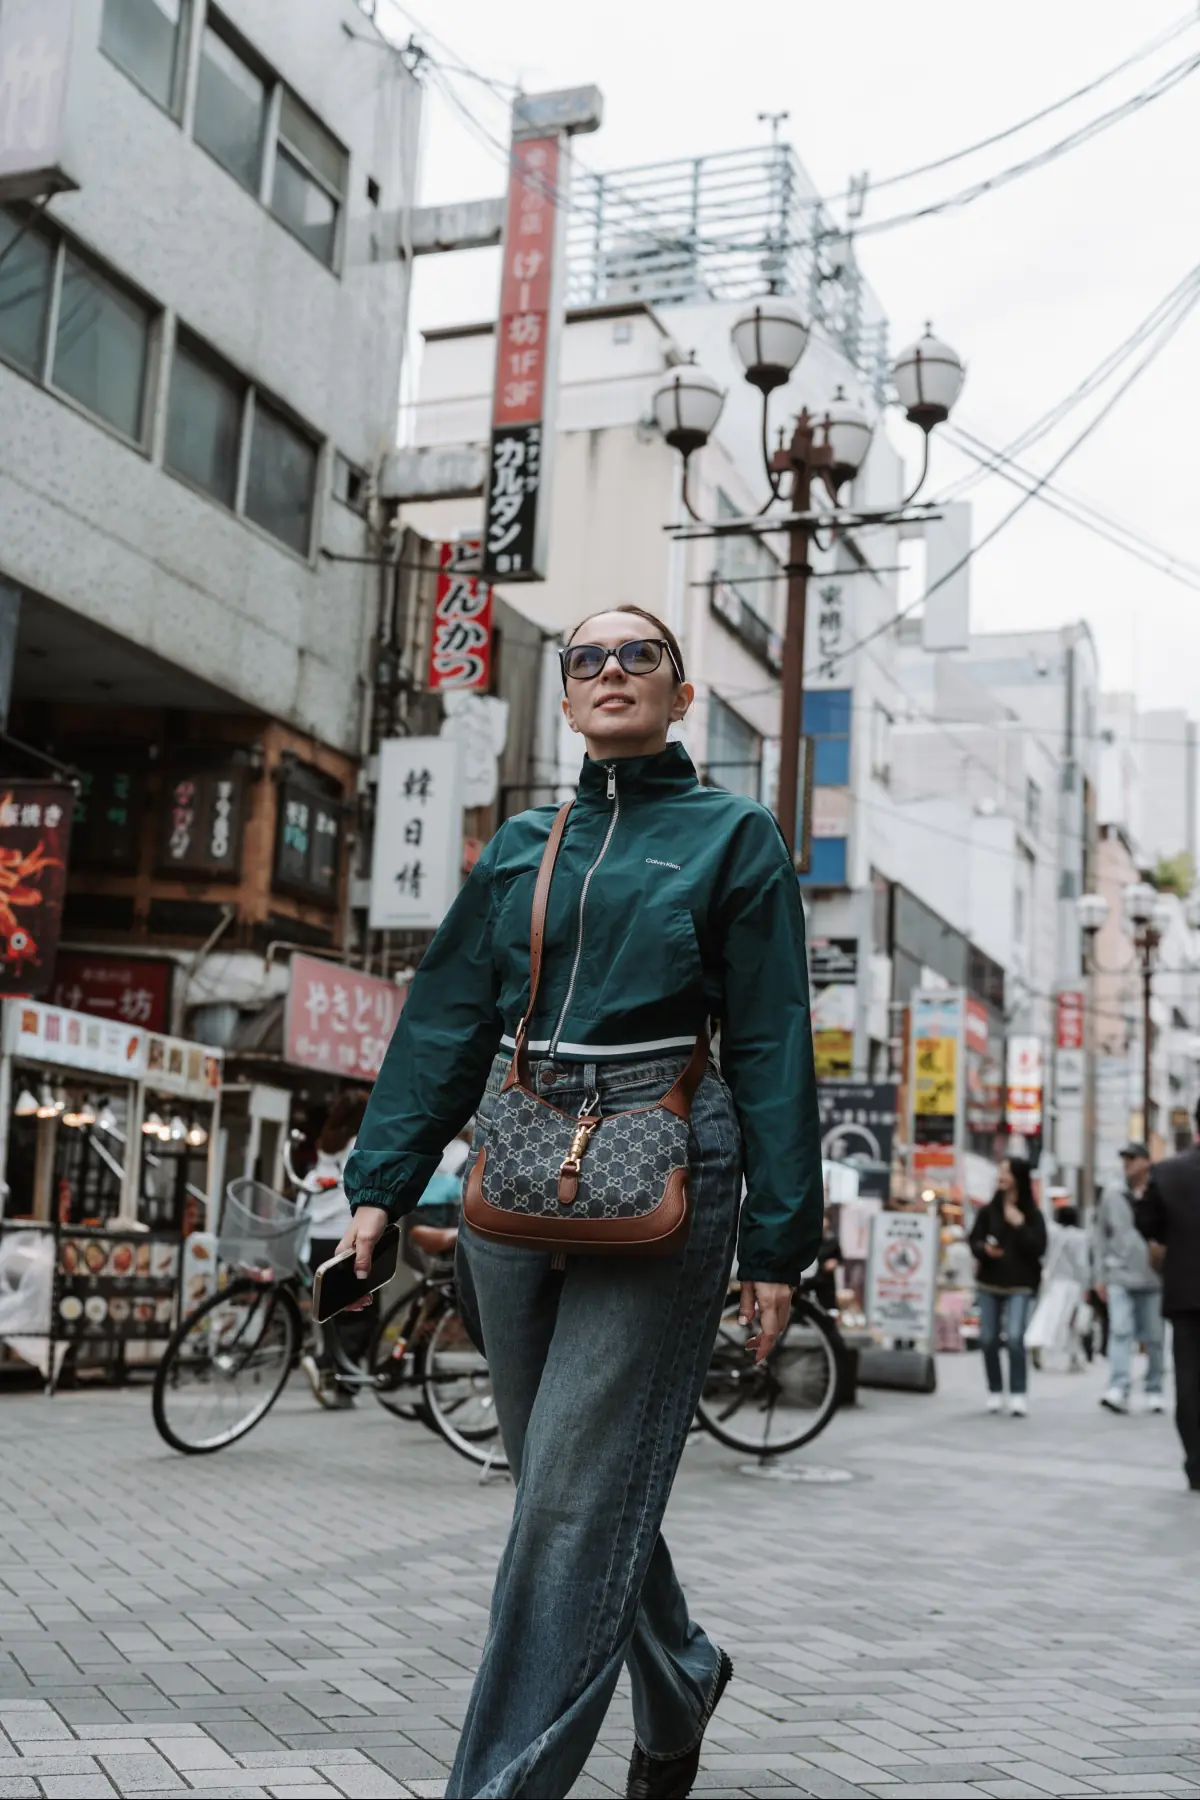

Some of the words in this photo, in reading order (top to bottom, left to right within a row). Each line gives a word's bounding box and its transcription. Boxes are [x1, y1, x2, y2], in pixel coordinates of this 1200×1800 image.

[507, 248, 543, 345] けー坊
[510, 348, 540, 376] 1F
[487, 437, 525, 553] カルタン
[434, 542, 489, 688] とんかつ
[645, 857, 666, 866] Calvin
[666, 861, 681, 871] Klein
[303, 980, 394, 1036] やきとり
